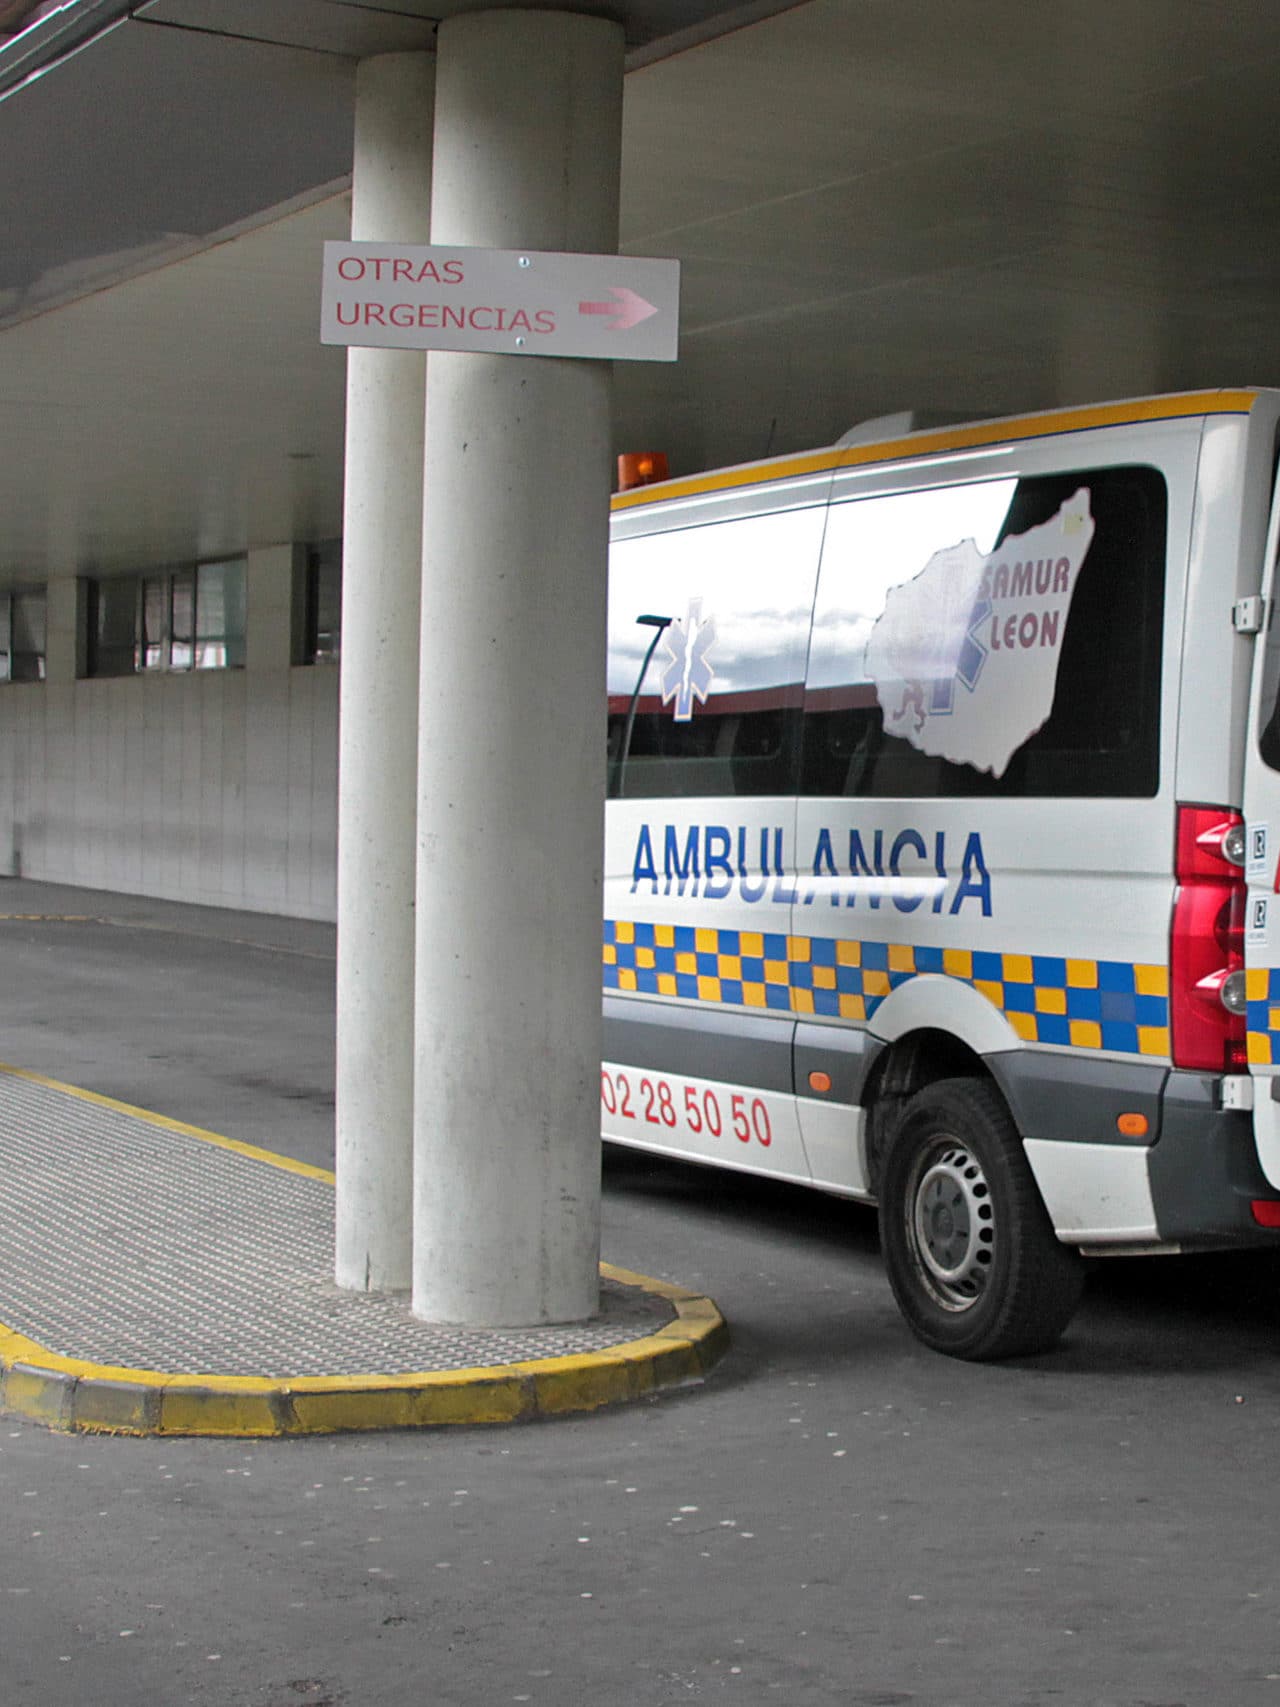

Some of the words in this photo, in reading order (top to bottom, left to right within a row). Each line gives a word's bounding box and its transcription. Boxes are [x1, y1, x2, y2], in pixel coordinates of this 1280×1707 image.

[337, 257, 465, 284] OTRAS
[336, 302, 557, 334] URGENCIAS
[979, 556, 1070, 600] SAMUR
[990, 610, 1060, 650] LEON
[630, 824, 992, 917] AMBULANCIA
[641, 1078, 677, 1127] 28
[684, 1086, 722, 1137] 50
[731, 1094, 772, 1147] 50
